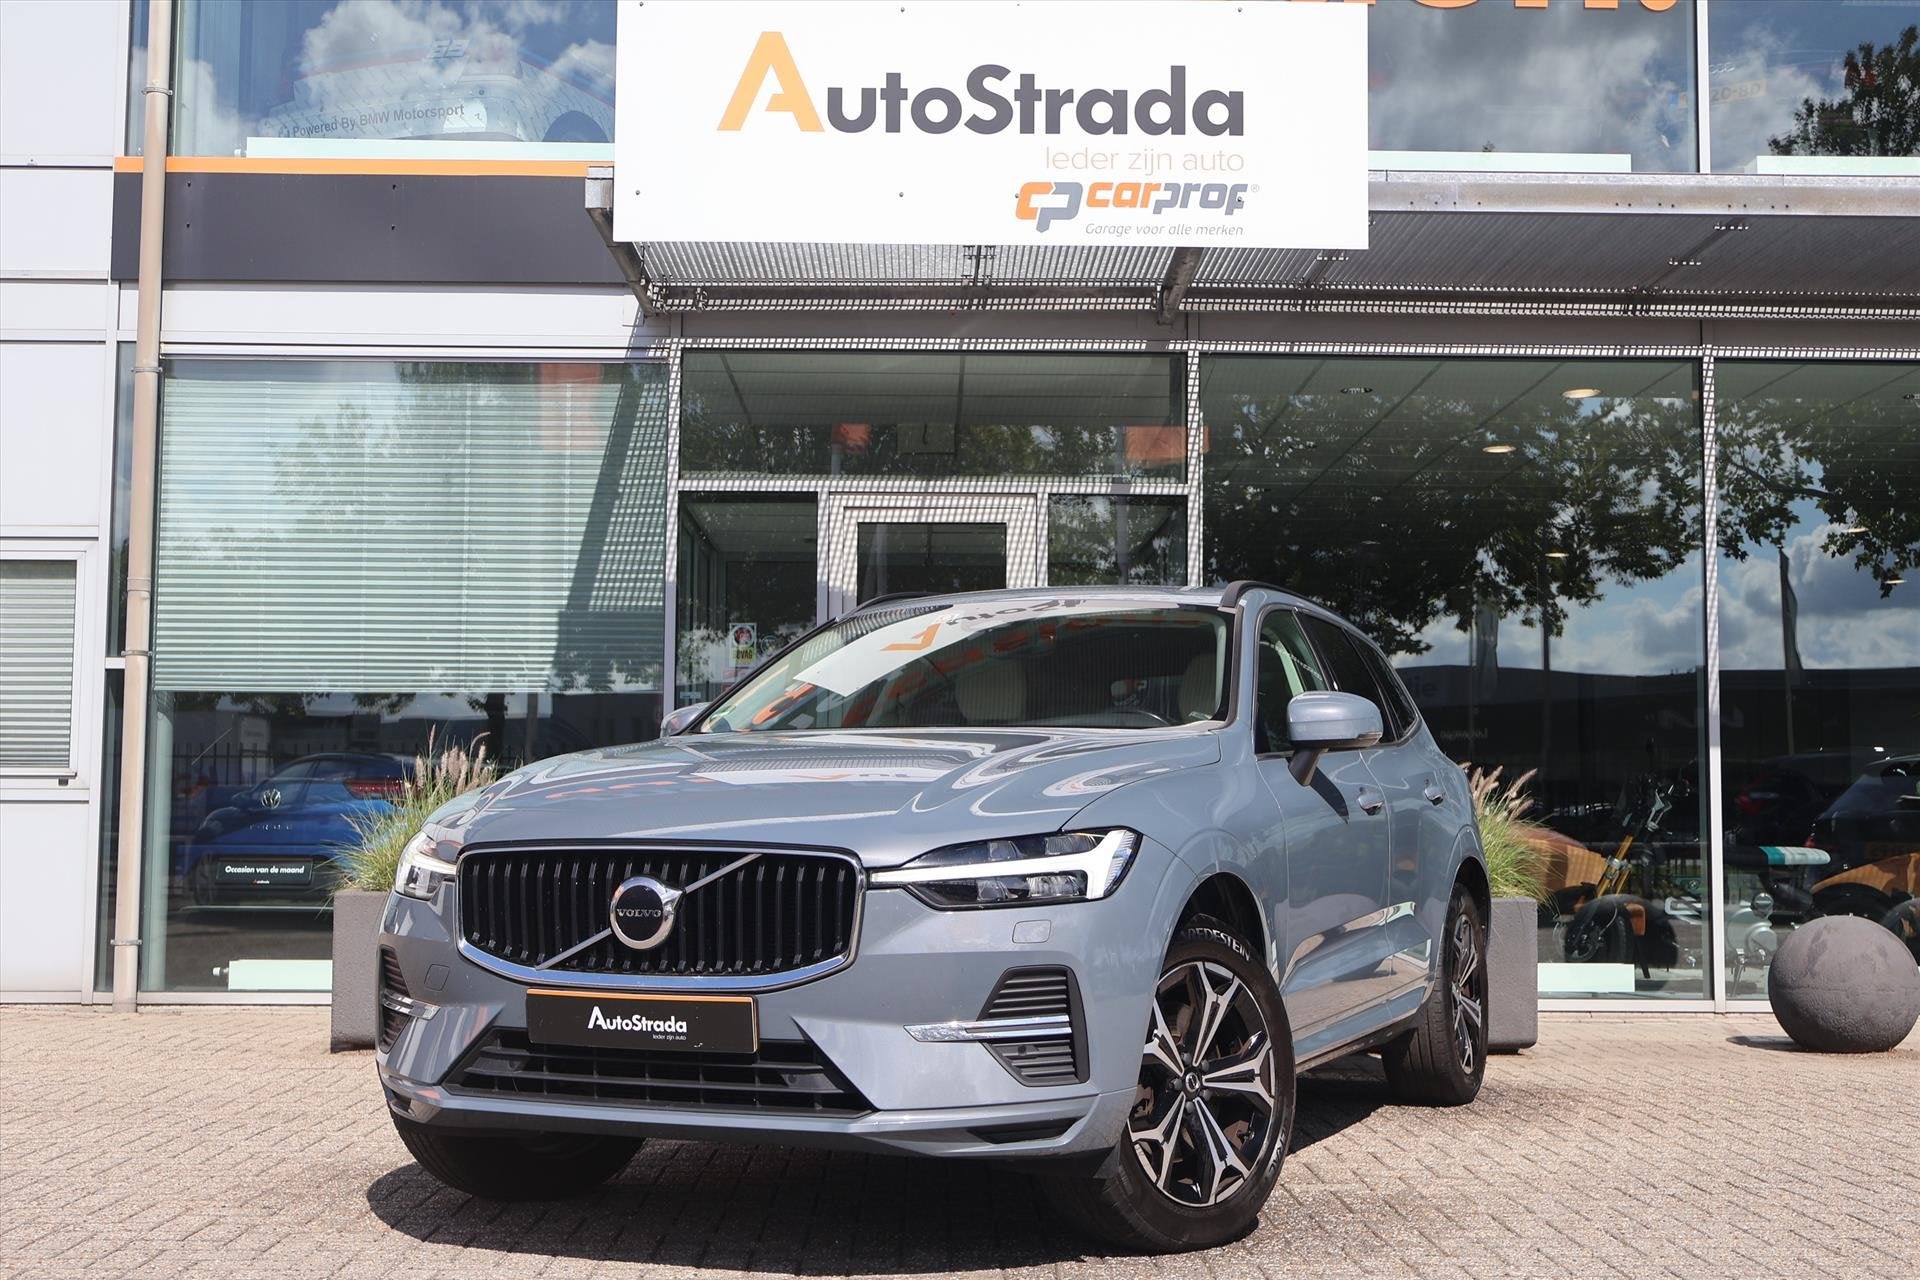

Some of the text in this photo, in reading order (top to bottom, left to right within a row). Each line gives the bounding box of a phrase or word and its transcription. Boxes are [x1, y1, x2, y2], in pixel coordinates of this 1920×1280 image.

[716, 31, 1245, 136] AutoStrada
[293, 119, 338, 138] Powered
[341, 116, 356, 130] By
[359, 109, 390, 127] BMW
[393, 104, 465, 122] Motorsport
[1045, 147, 1245, 176] Ieder zijn auto
[1085, 222, 1244, 238] Garage voor alle merken
[225, 865, 255, 874] Occasion
[270, 865, 279, 874] de
[280, 866, 305, 874] maand
[617, 908, 662, 918] VOLVO
[587, 1005, 688, 1034] AutoStrada
